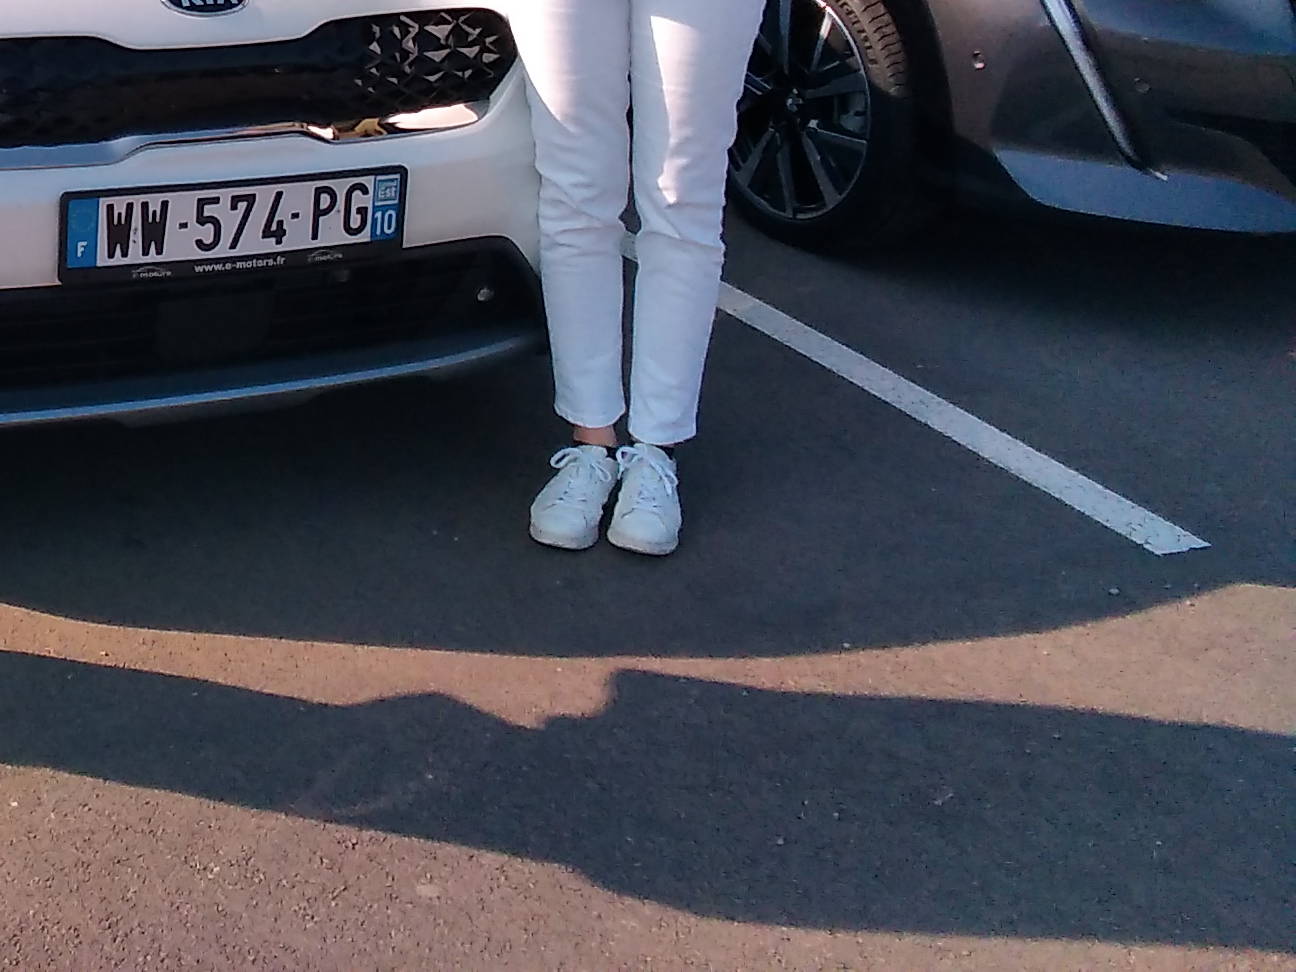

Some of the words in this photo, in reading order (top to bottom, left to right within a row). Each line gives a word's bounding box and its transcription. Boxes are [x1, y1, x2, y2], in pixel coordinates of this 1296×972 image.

[105, 182, 369, 259] WW-574-PG
[374, 209, 396, 236] 10
[76, 241, 88, 258] F
[194, 256, 286, 274] www.e-motors.fr
